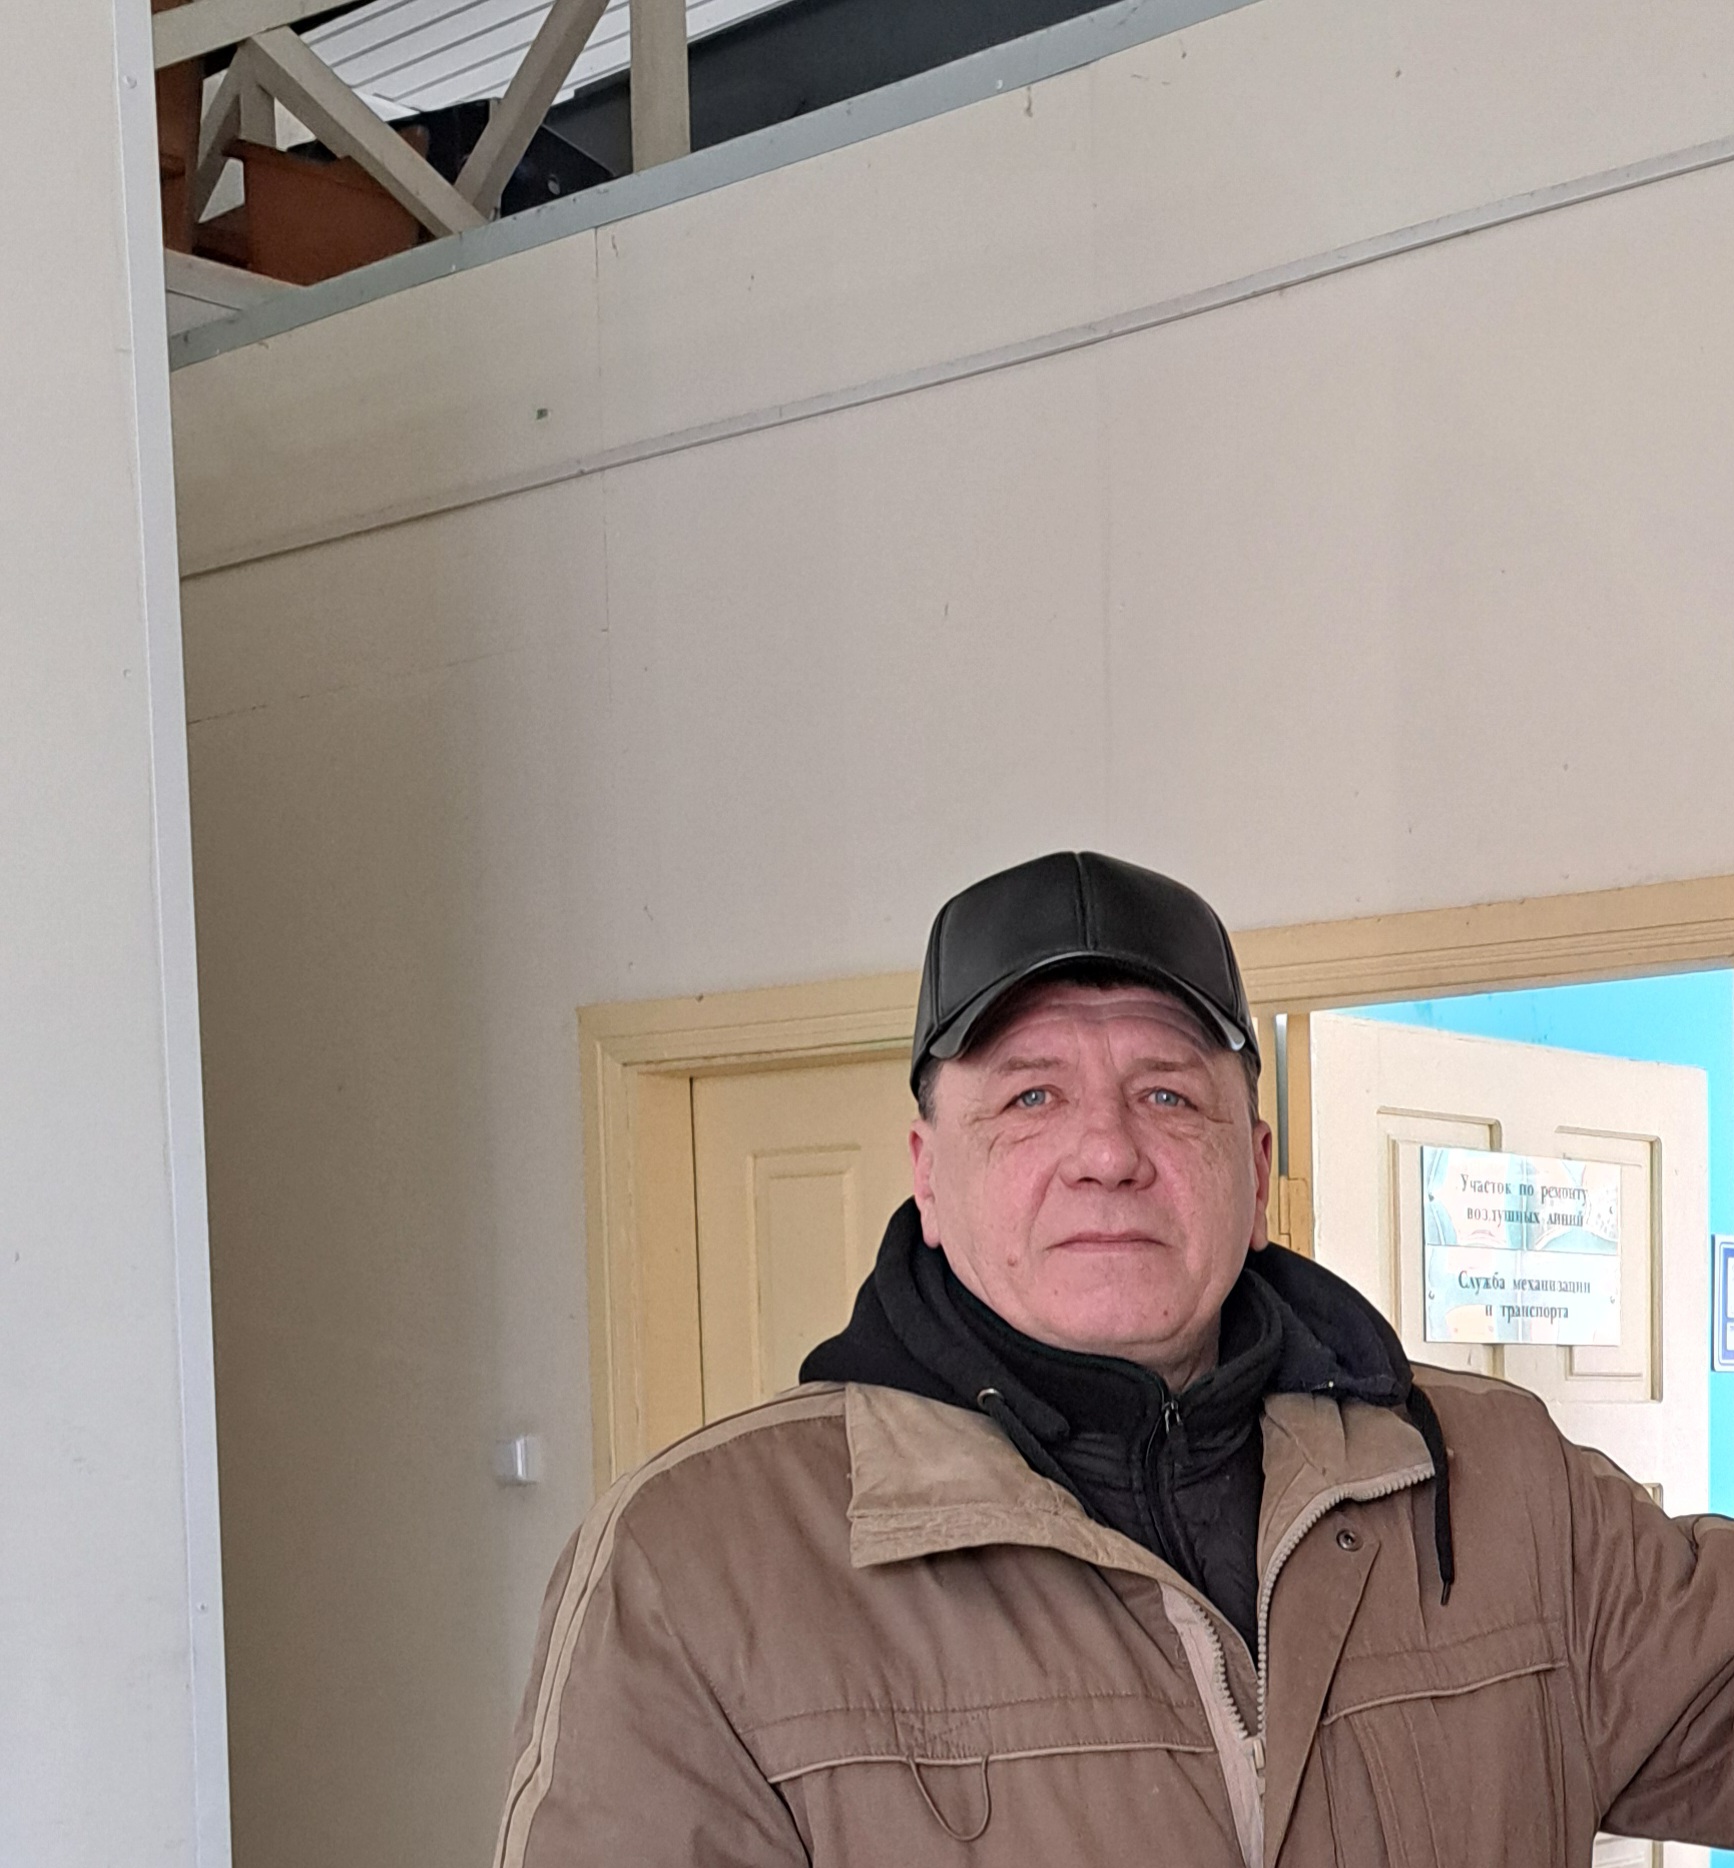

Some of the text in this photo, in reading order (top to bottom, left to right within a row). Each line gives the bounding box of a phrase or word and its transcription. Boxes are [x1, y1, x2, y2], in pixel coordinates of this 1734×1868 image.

[1460, 1173, 1588, 1207] Участок по ремонту
[1467, 1207, 1584, 1228] воздушных линий
[1458, 1270, 1591, 1296] Служба механизации
[1485, 1304, 1569, 1325] и транспорта
